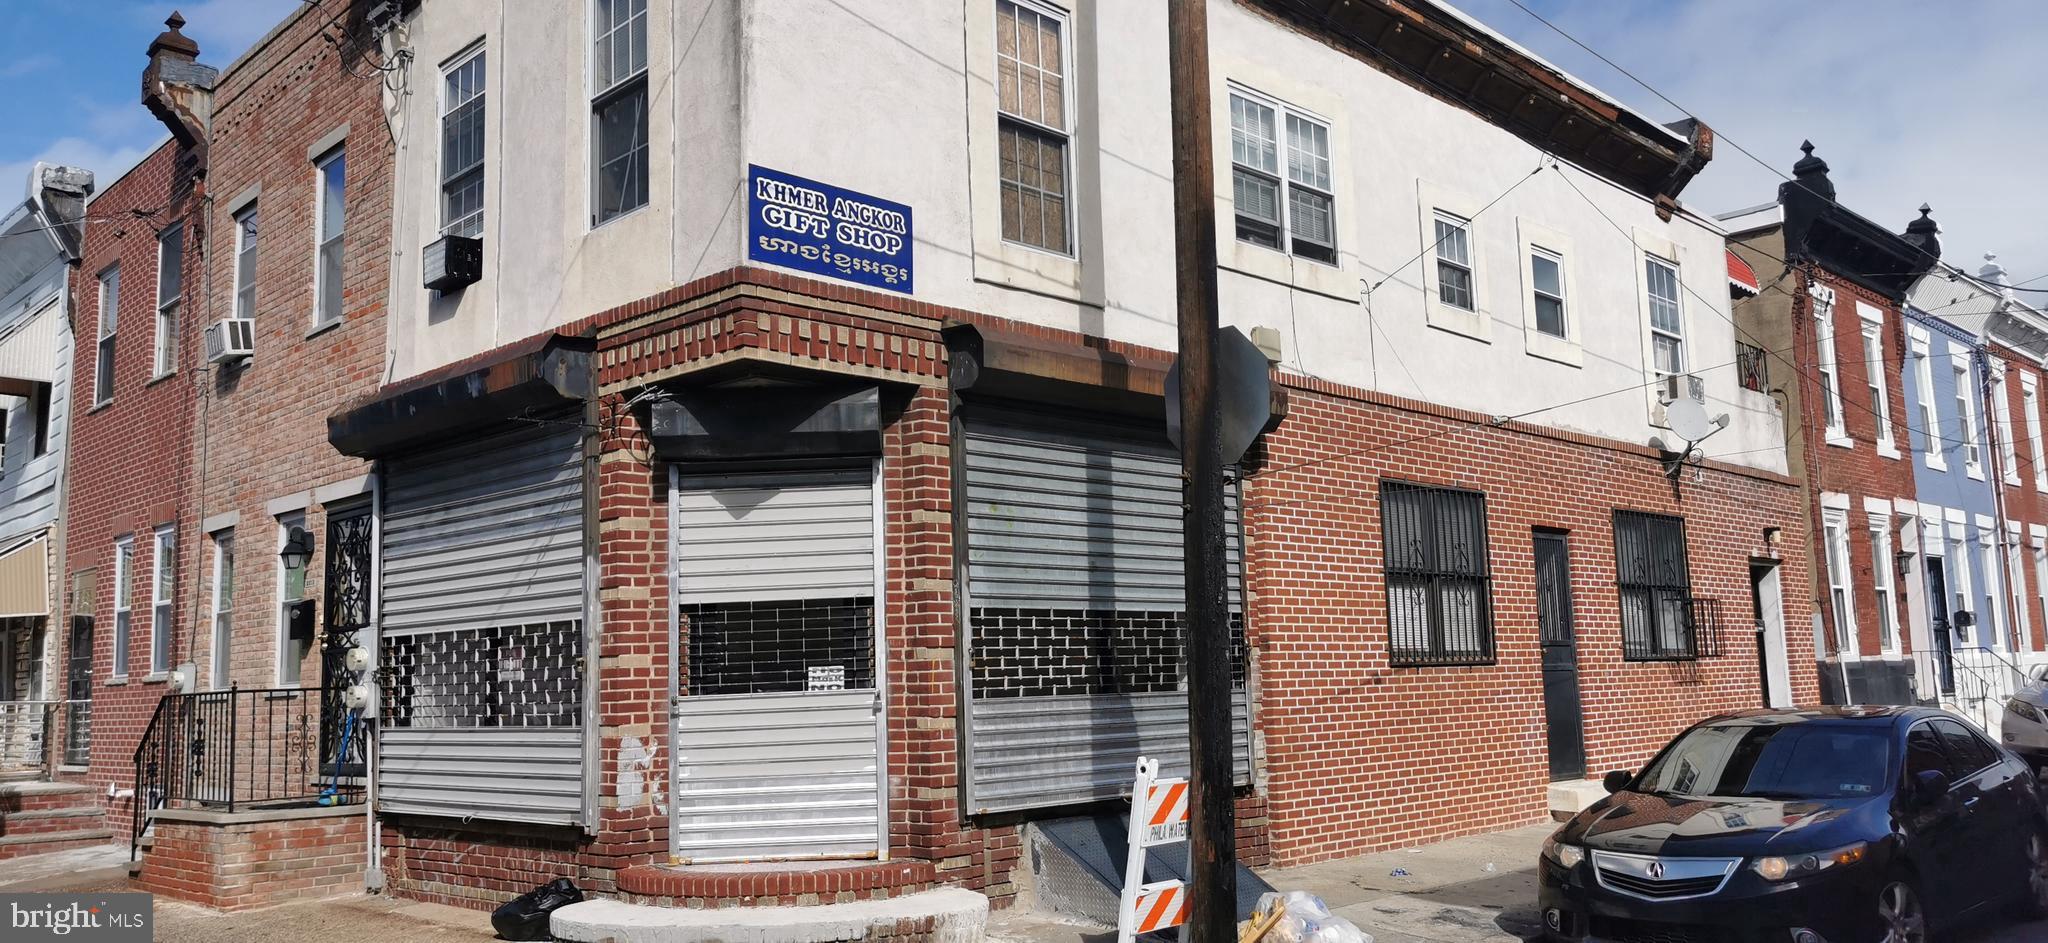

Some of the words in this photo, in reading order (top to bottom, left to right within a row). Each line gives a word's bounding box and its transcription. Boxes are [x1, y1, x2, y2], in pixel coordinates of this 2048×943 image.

[757, 178, 828, 214] KHMER
[832, 197, 906, 234] ANGKOR
[762, 205, 830, 239] GIFT
[837, 223, 902, 255] SHOP
